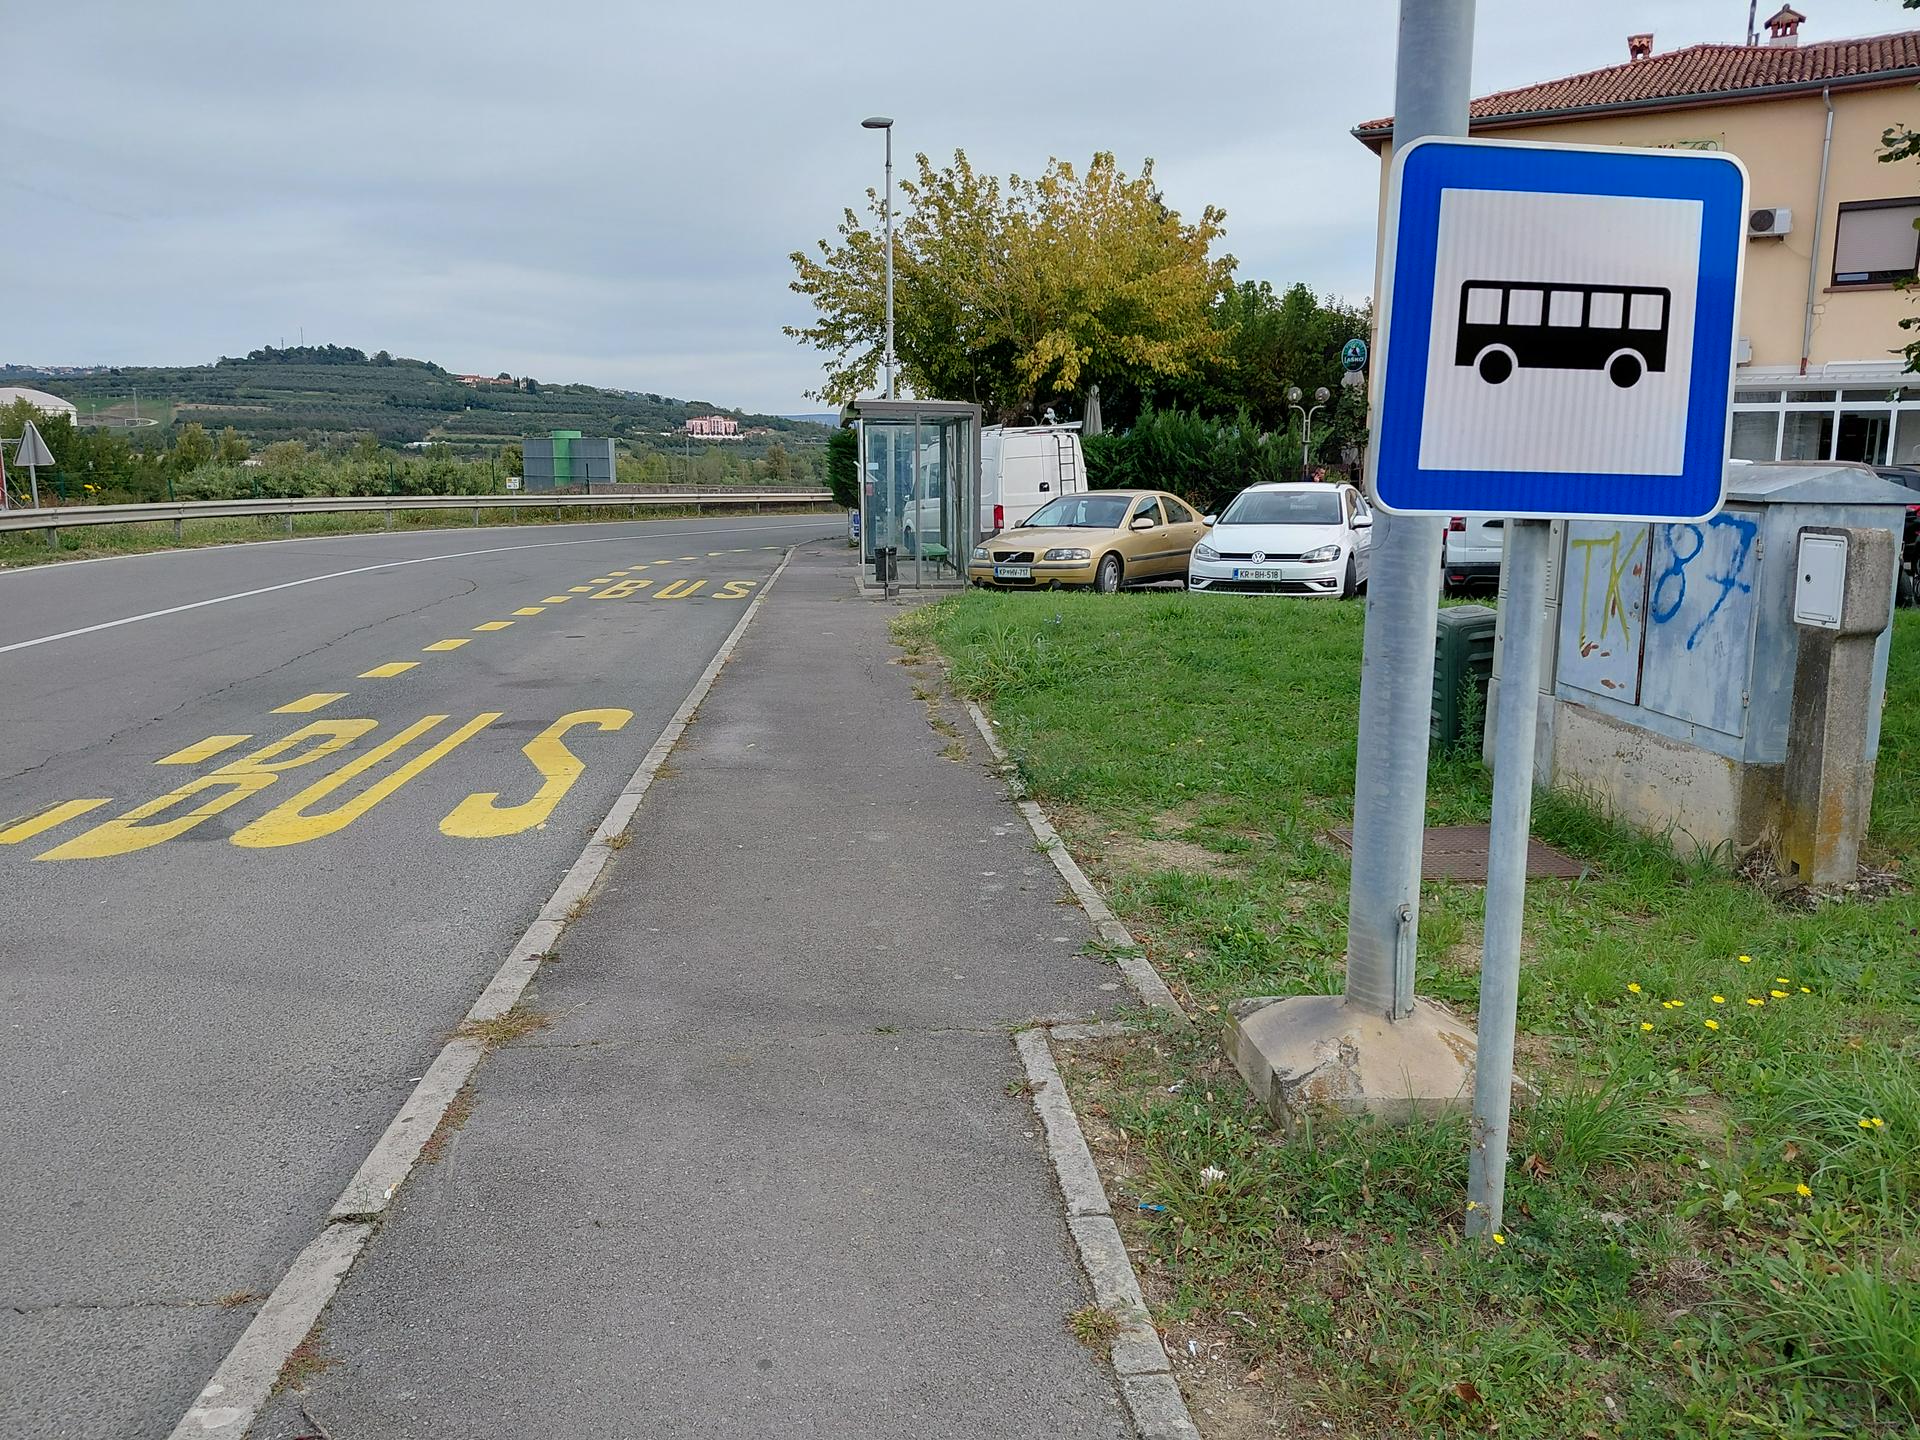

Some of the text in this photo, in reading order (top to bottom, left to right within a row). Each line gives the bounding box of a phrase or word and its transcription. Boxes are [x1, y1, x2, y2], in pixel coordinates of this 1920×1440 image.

[588, 579, 757, 600] BUS
[1571, 513, 1758, 650] TK 87
[36, 708, 635, 861] BUS
